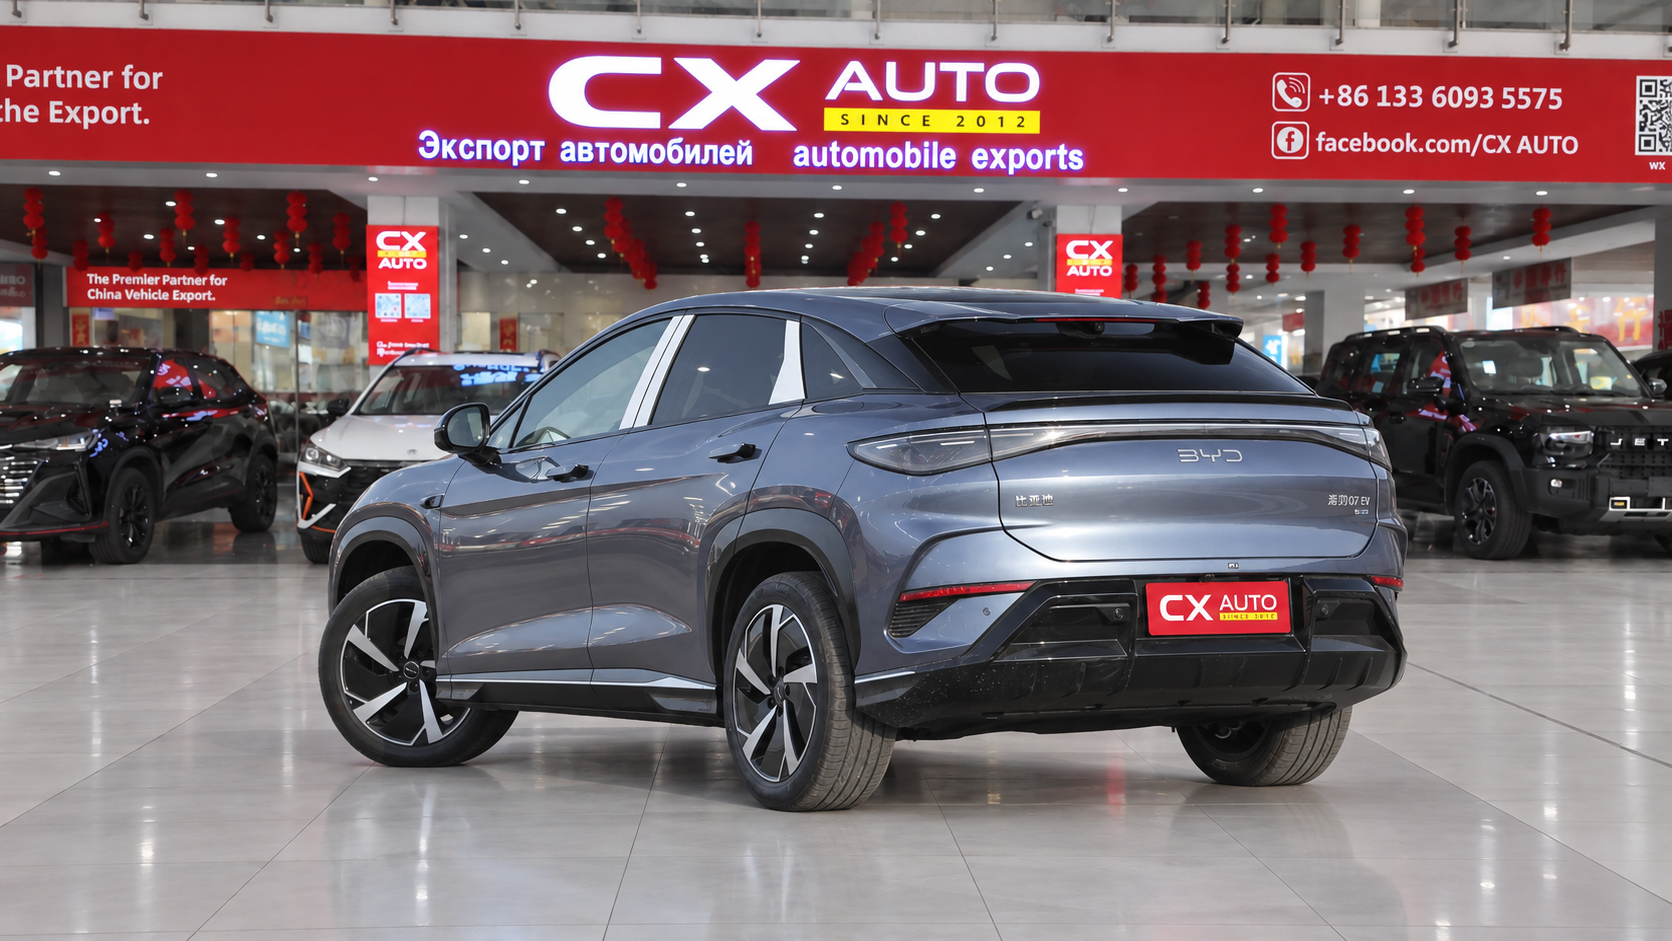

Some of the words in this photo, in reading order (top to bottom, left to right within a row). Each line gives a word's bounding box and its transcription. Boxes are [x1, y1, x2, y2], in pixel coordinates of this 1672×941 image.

[6, 64, 113, 89] Partner
[122, 64, 164, 90] for
[548, 54, 801, 131] CX
[825, 61, 1041, 103] AUTO
[1318, 84, 1369, 107] +86
[1377, 85, 1423, 107] 133
[1432, 86, 1494, 109] 6093
[1502, 87, 1563, 110] 5575
[49, 100, 150, 129] Export.
[840, 113, 931, 127] SINCE
[956, 115, 1026, 128] 2012
[418, 130, 545, 166] Экспорт
[559, 137, 753, 165] автомобилей
[1315, 131, 1511, 157] facebook.com/CX
[1516, 135, 1579, 155] AUTO
[793, 140, 957, 170] automobile
[971, 143, 1085, 172] exports
[1648, 161, 1666, 171] WX
[376, 230, 427, 250] CX
[1066, 239, 1114, 259] CX
[378, 257, 428, 269] AUTO
[1066, 266, 1113, 277] AUTO
[86, 273, 110, 285] The
[112, 273, 160, 286] Premier
[162, 274, 208, 286] Partner
[210, 274, 228, 286] for
[87, 288, 122, 300] China
[125, 288, 170, 301] Vehicle
[172, 290, 216, 303] Export.
[1177, 448, 1243, 463] BYD
[1015, 494, 1054, 508] 比亚迪
[1159, 594, 1214, 622] CX
[1219, 594, 1278, 612] AUTO
